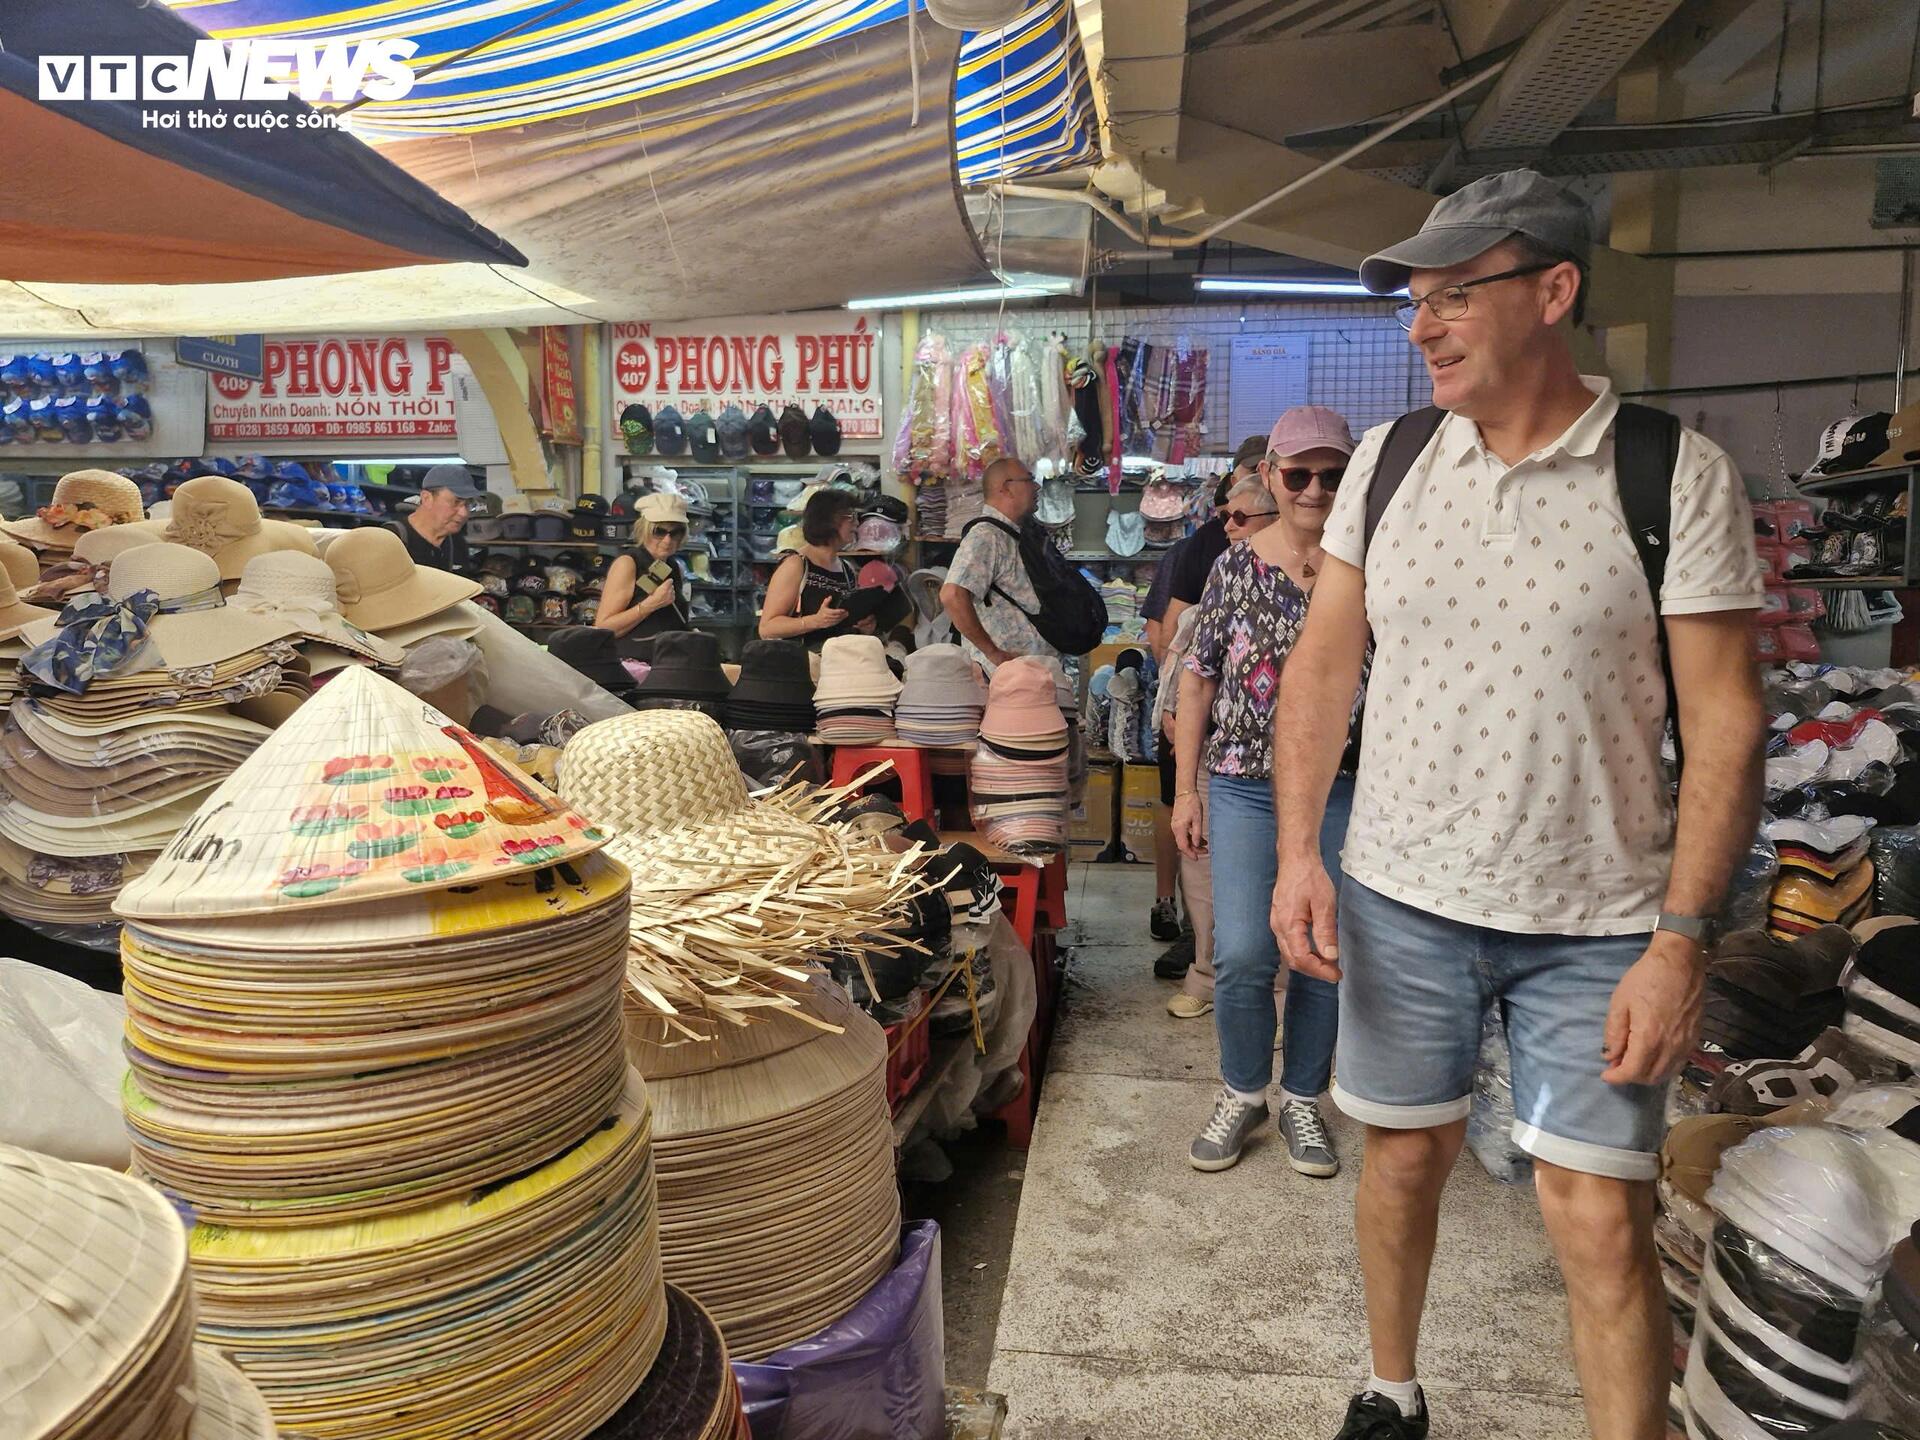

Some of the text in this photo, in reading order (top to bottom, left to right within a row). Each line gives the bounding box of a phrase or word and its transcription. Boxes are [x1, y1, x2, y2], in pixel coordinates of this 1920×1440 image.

[614, 321, 651, 338] NÓN
[203, 352, 239, 369] CLOTH
[620, 351, 646, 367] Sạp
[655, 334, 783, 395] PHONG
[795, 316, 875, 394] PHÚ
[259, 338, 412, 397] PHONG
[219, 376, 249, 391] 408
[621, 372, 647, 386] 407
[214, 404, 257, 421] Chuyên
[261, 403, 286, 417] Kinh
[291, 402, 331, 416] Doanh:
[336, 398, 381, 416] NÓN
[388, 396, 439, 415] THỜI
[265, 423, 289, 436] 3859
[292, 422, 317, 435] 4001
[346, 421, 372, 434] 0985
[374, 421, 393, 434] 861
[397, 421, 416, 434] 168
[428, 420, 452, 434] Zalo:
